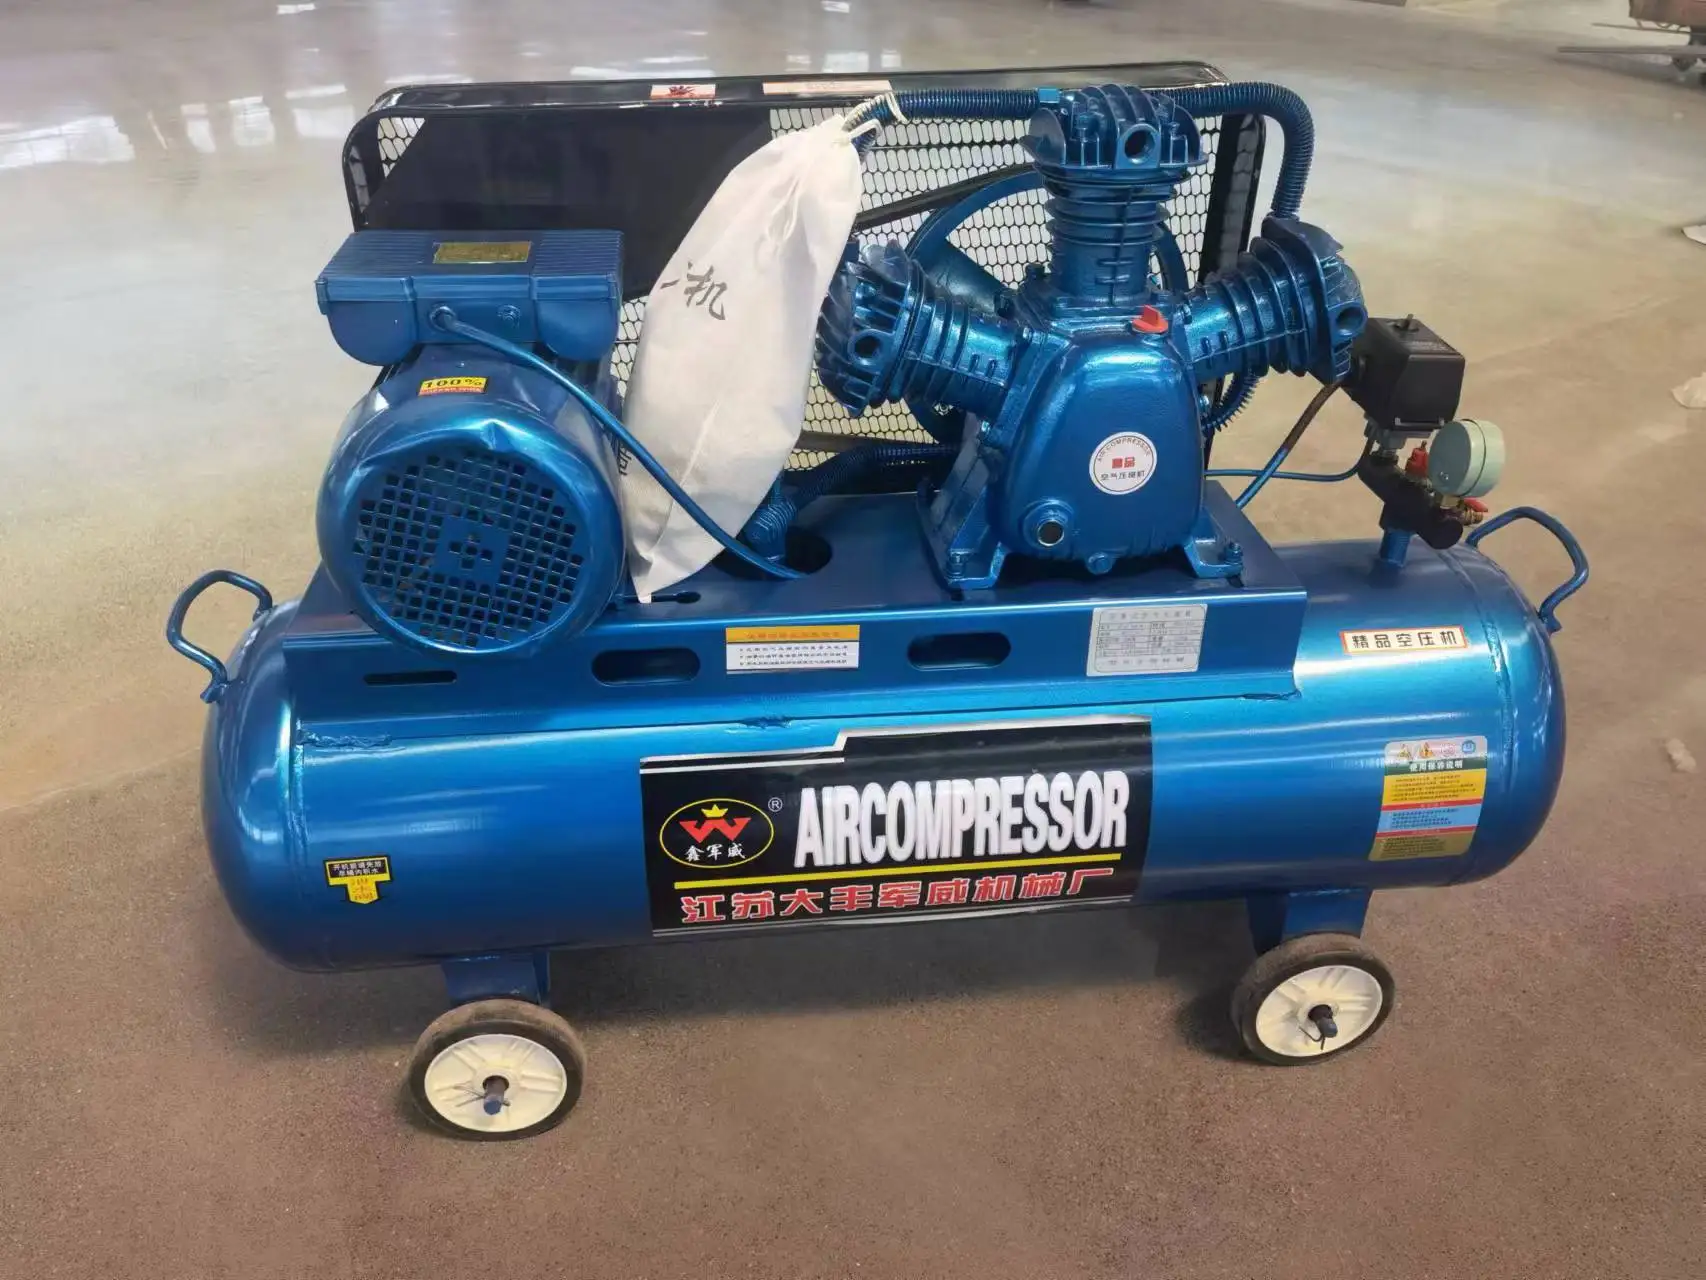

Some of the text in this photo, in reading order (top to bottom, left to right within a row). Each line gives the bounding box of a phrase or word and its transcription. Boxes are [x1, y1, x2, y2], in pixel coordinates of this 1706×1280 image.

[425, 378, 482, 388] 100%
[1352, 630, 1458, 648] 精品空压机
[794, 769, 1129, 868] AIRCOMPRESSOR
